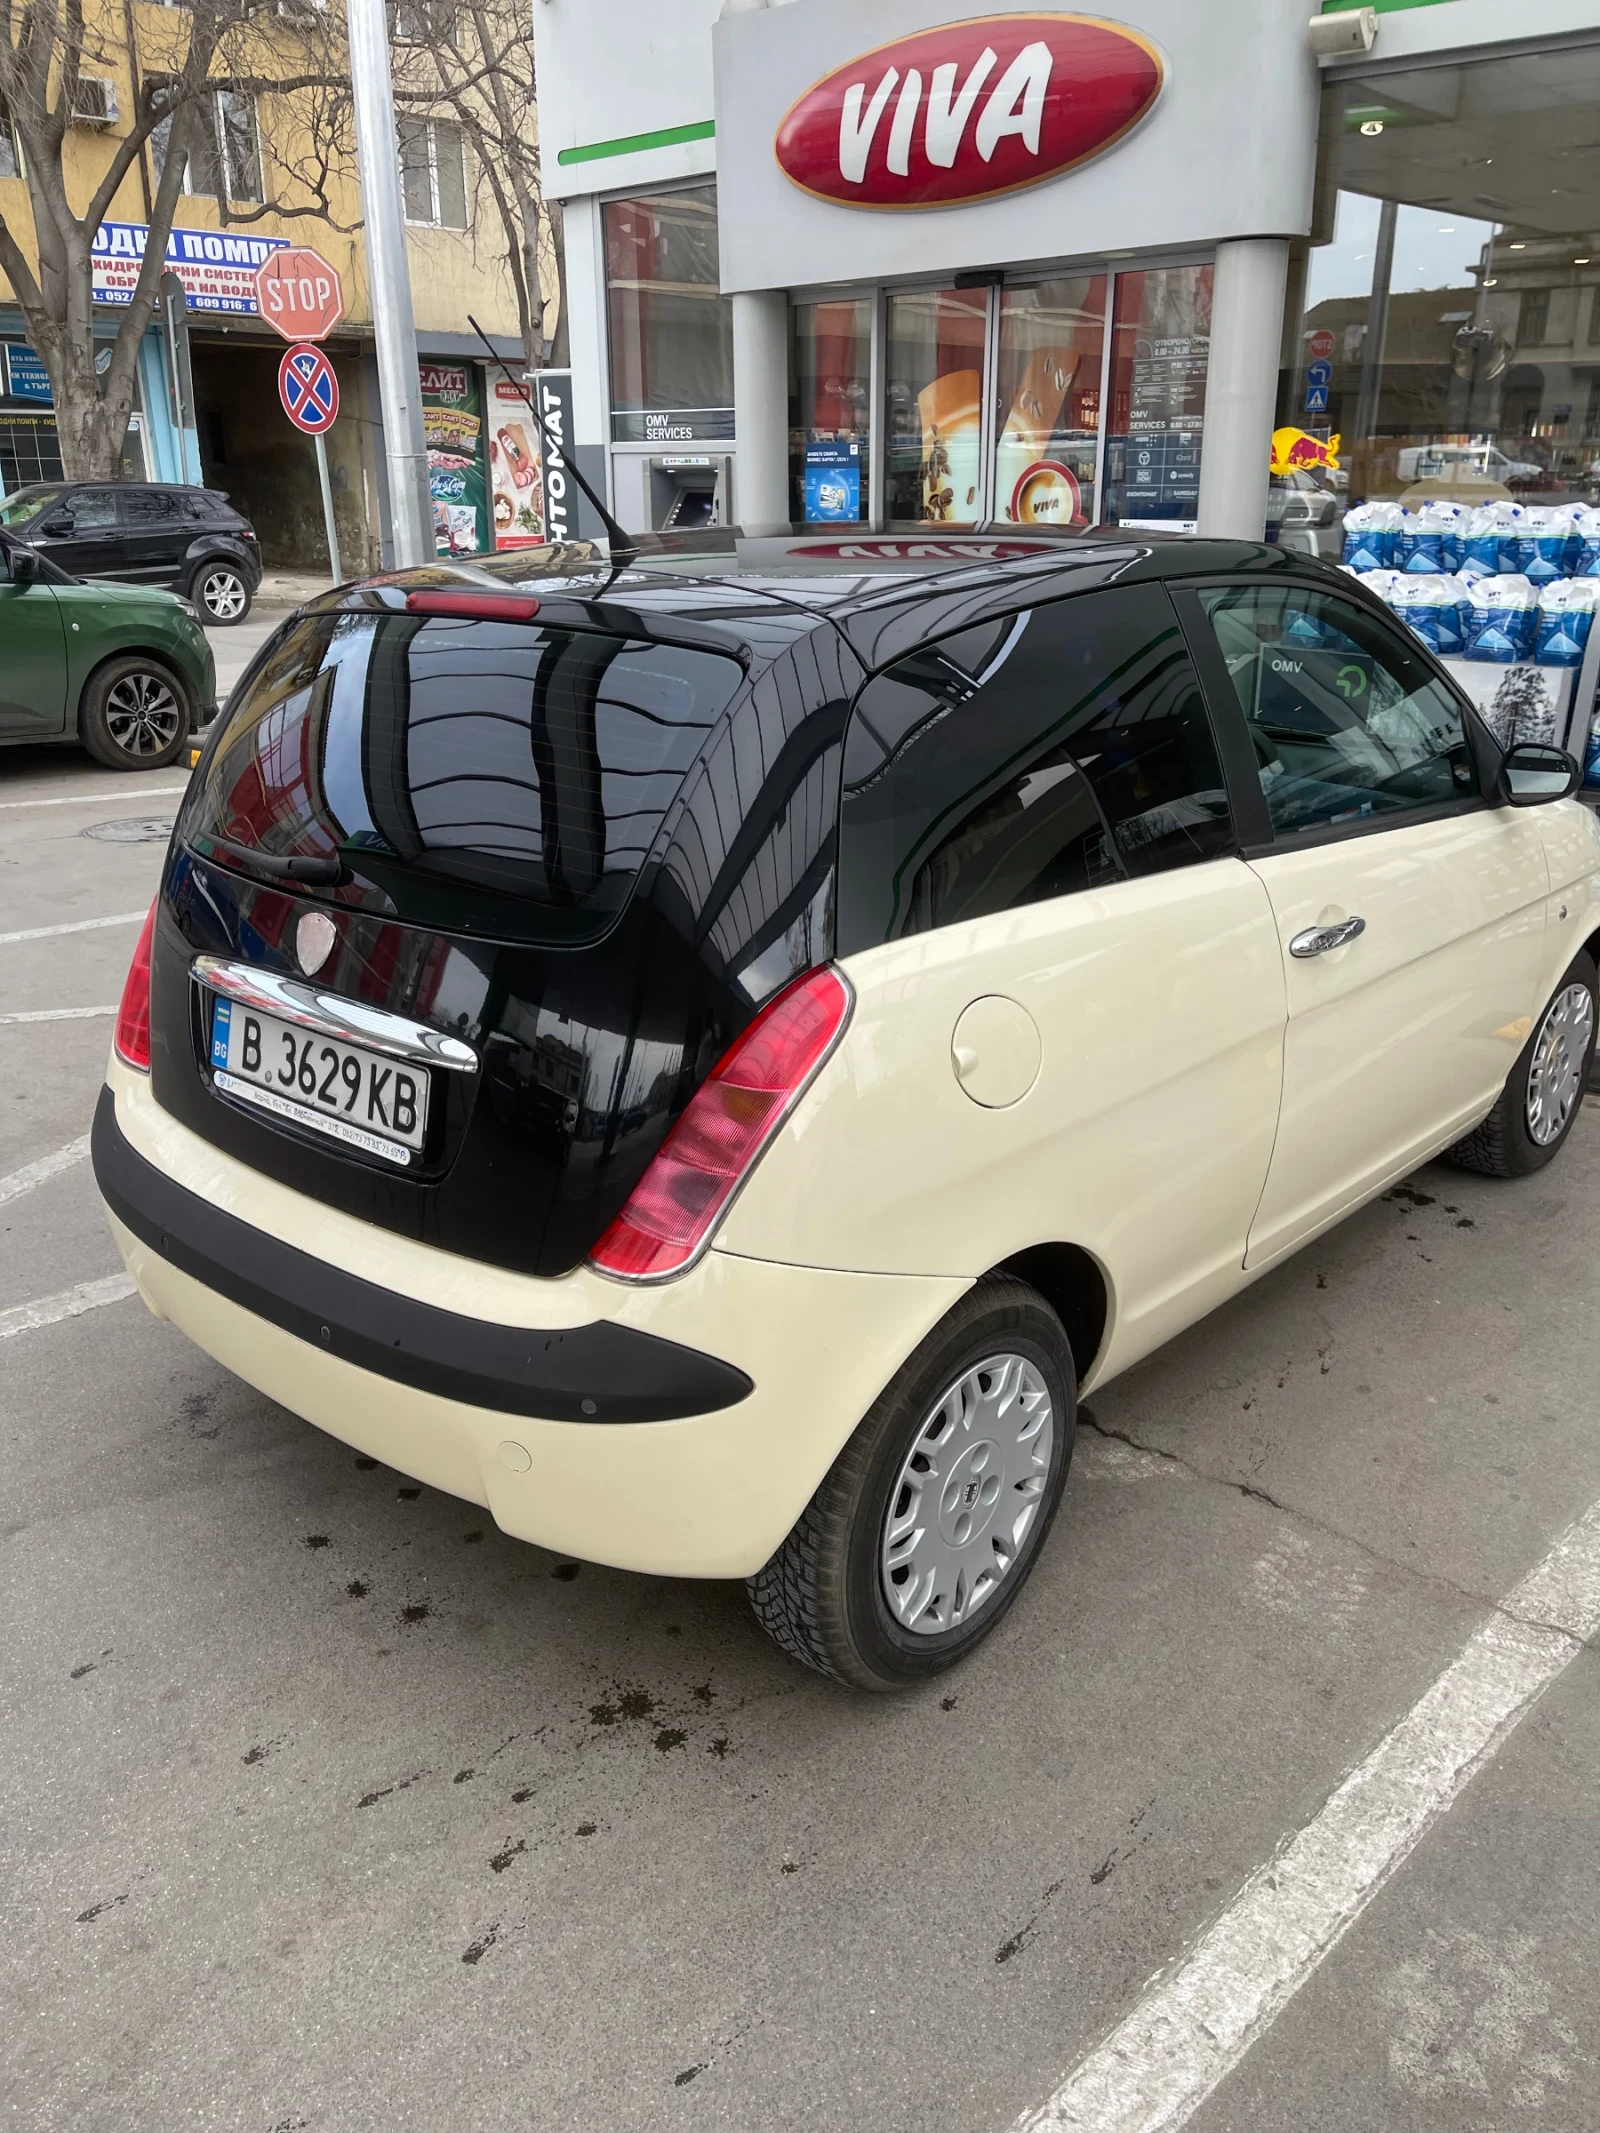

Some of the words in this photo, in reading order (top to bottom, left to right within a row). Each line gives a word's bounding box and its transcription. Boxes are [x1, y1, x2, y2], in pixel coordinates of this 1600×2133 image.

[838, 40, 1054, 184] VIVA
[182, 235, 279, 264] ПОМП
[199, 283, 218, 294] НА
[267, 278, 331, 312] STOP
[196, 297, 219, 308] 609
[646, 414, 669, 427] OMV
[1130, 410, 1149, 419] OMV
[1129, 420, 1166, 430] SERVICES
[646, 427, 692, 440] SERVICES
[1033, 499, 1060, 513] VIVA
[1271, 659, 1303, 673] OMV
[214, 1040, 227, 1059] BG
[241, 1016, 263, 1073] B
[278, 1032, 362, 1112] 3629
[367, 1063, 417, 1135] KB
